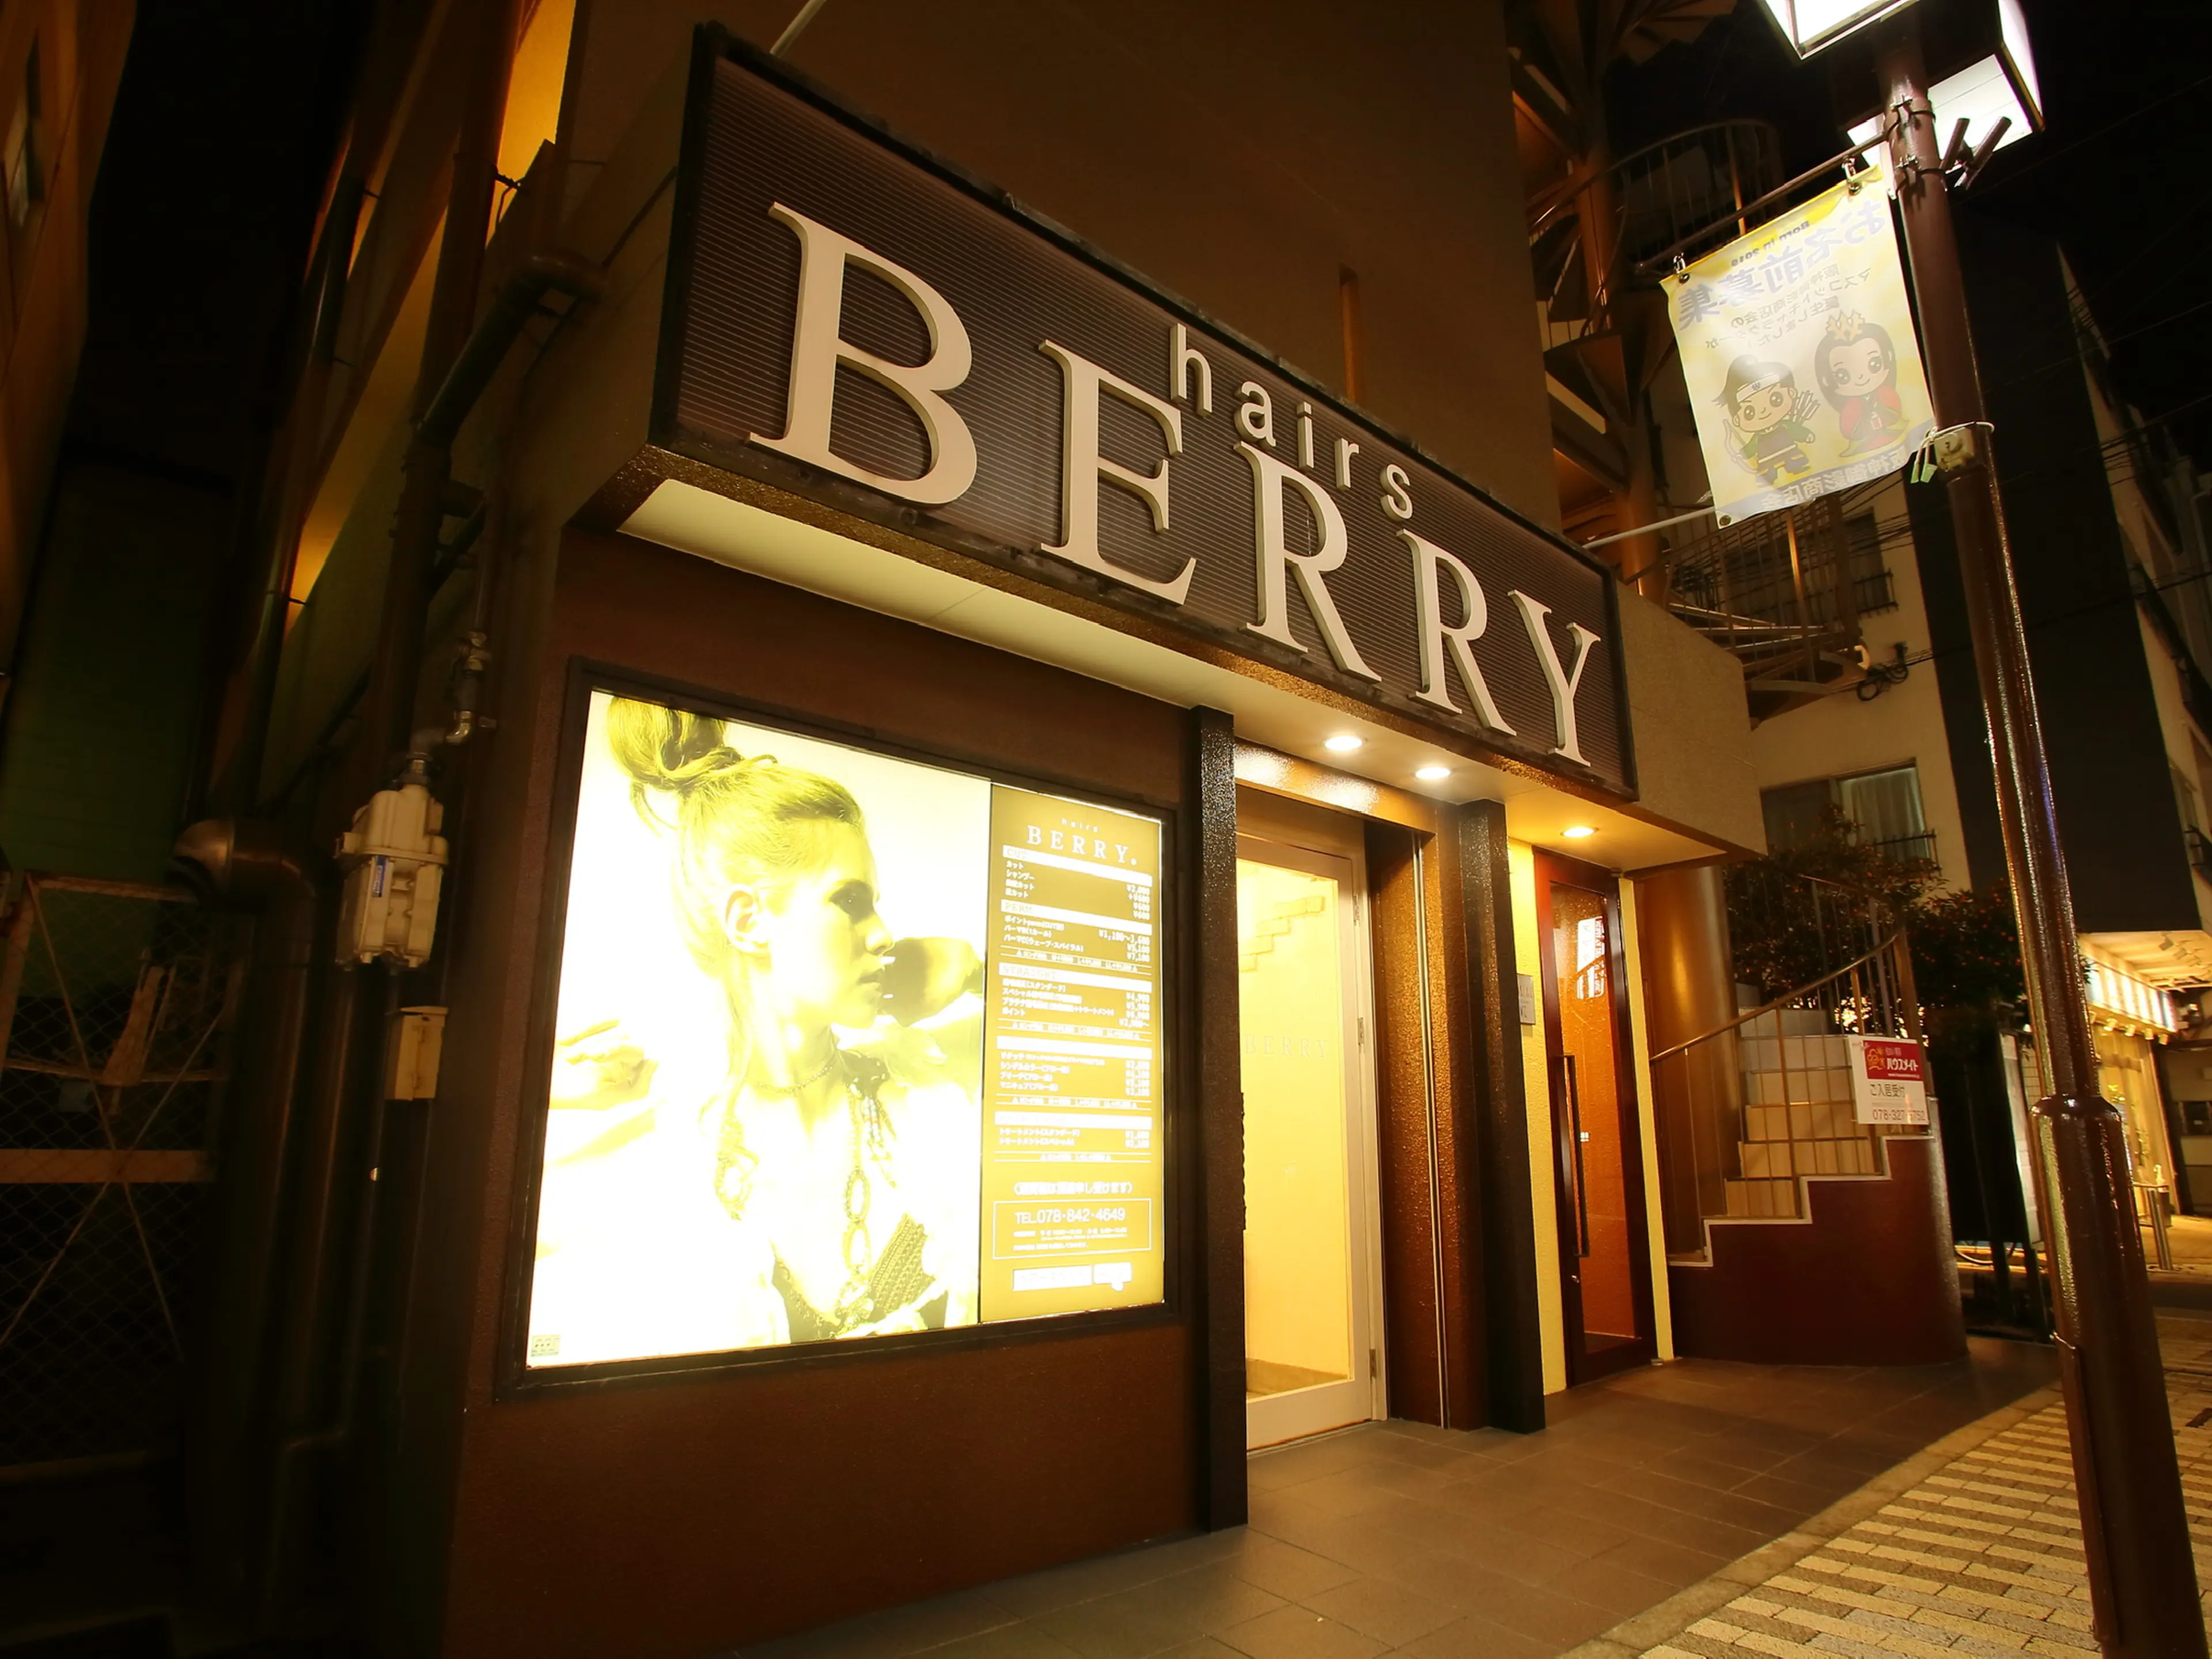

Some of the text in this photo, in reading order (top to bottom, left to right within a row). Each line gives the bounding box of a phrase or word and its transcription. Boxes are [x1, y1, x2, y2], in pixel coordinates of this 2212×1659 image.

[747, 201, 1601, 767] BERRY
[1170, 323, 1413, 522] hairs
[1244, 1033, 1328, 1058] BERRY
